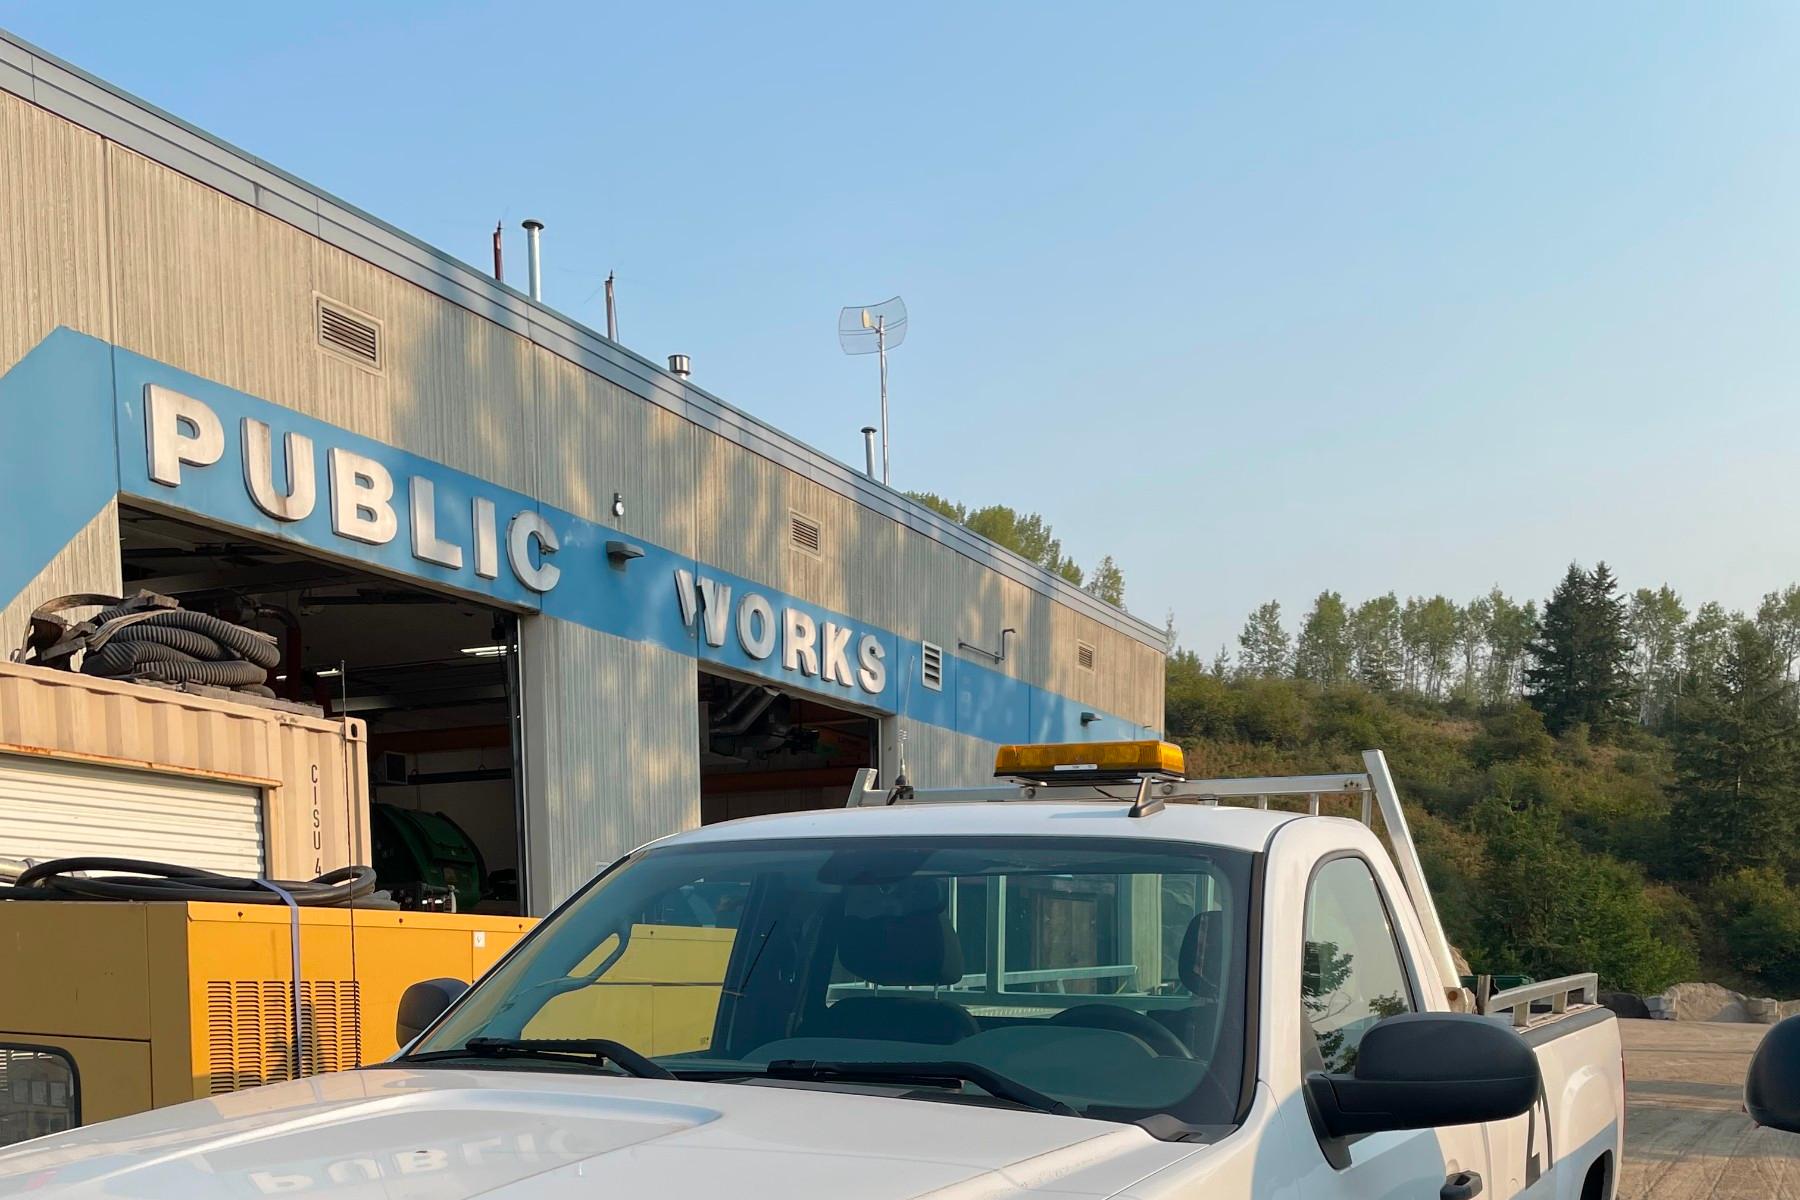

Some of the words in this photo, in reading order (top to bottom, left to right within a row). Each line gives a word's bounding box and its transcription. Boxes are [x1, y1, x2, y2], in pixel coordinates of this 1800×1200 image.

[144, 383, 561, 592] PUBLIC
[674, 568, 887, 694] WORKS
[311, 764, 321, 850] CISU
